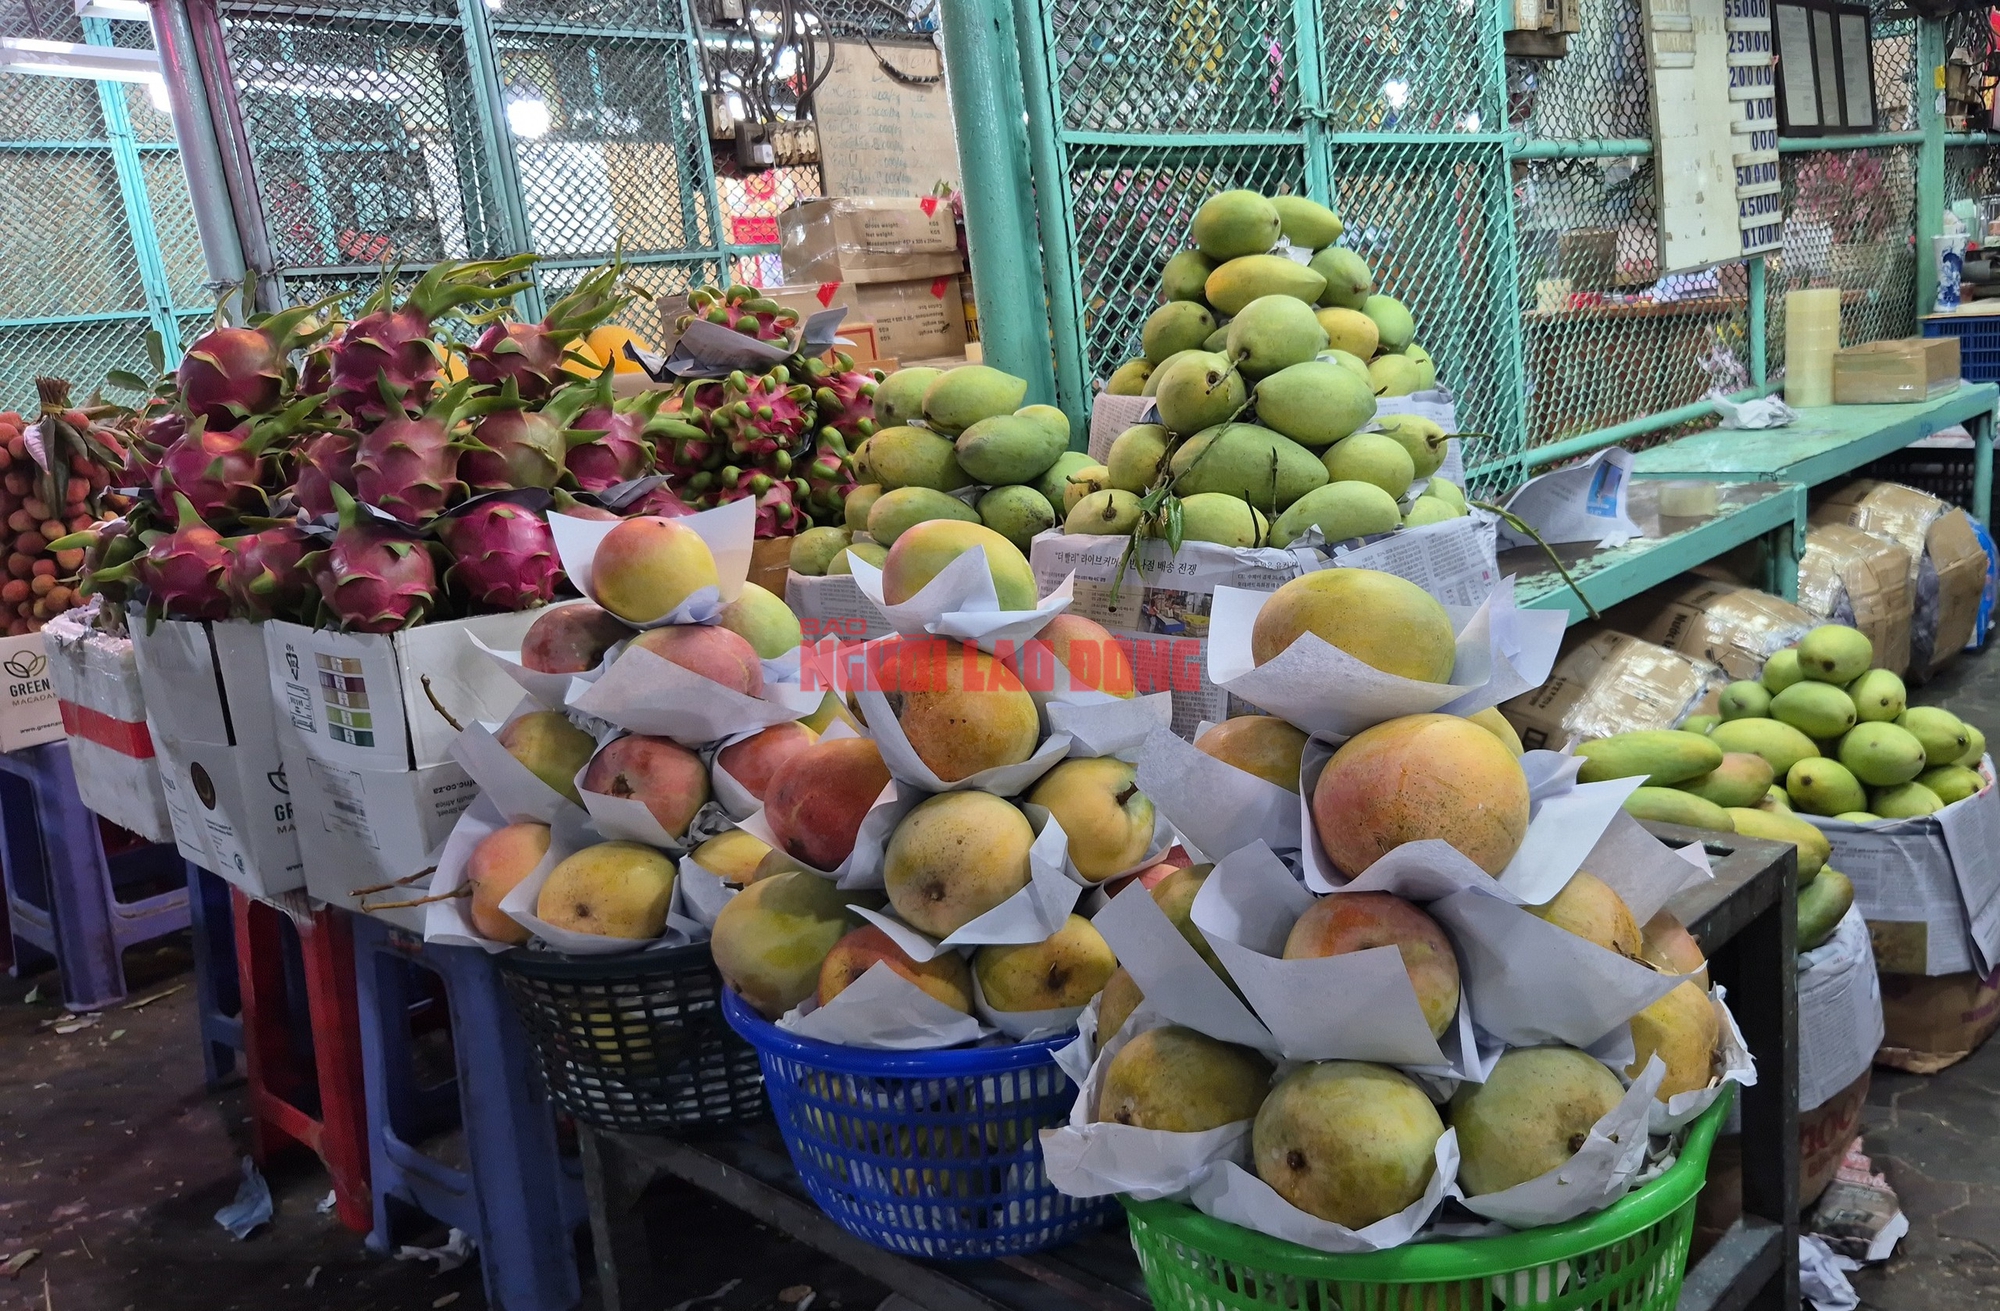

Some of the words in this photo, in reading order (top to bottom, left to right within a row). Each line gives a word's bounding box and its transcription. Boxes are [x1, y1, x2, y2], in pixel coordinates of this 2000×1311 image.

[1725, 0, 1766, 18] 55000
[1728, 32, 1769, 53] 25000
[1729, 66, 1771, 88] 20000
[1752, 129, 1775, 151] 000
[1736, 162, 1777, 187] 50000
[1740, 193, 1778, 218] 45000
[1742, 223, 1780, 249] 01000
[1158, 560, 1175, 574] 배송
[1178, 563, 1198, 576] 전쟁
[9, 678, 50, 698] GREEN
